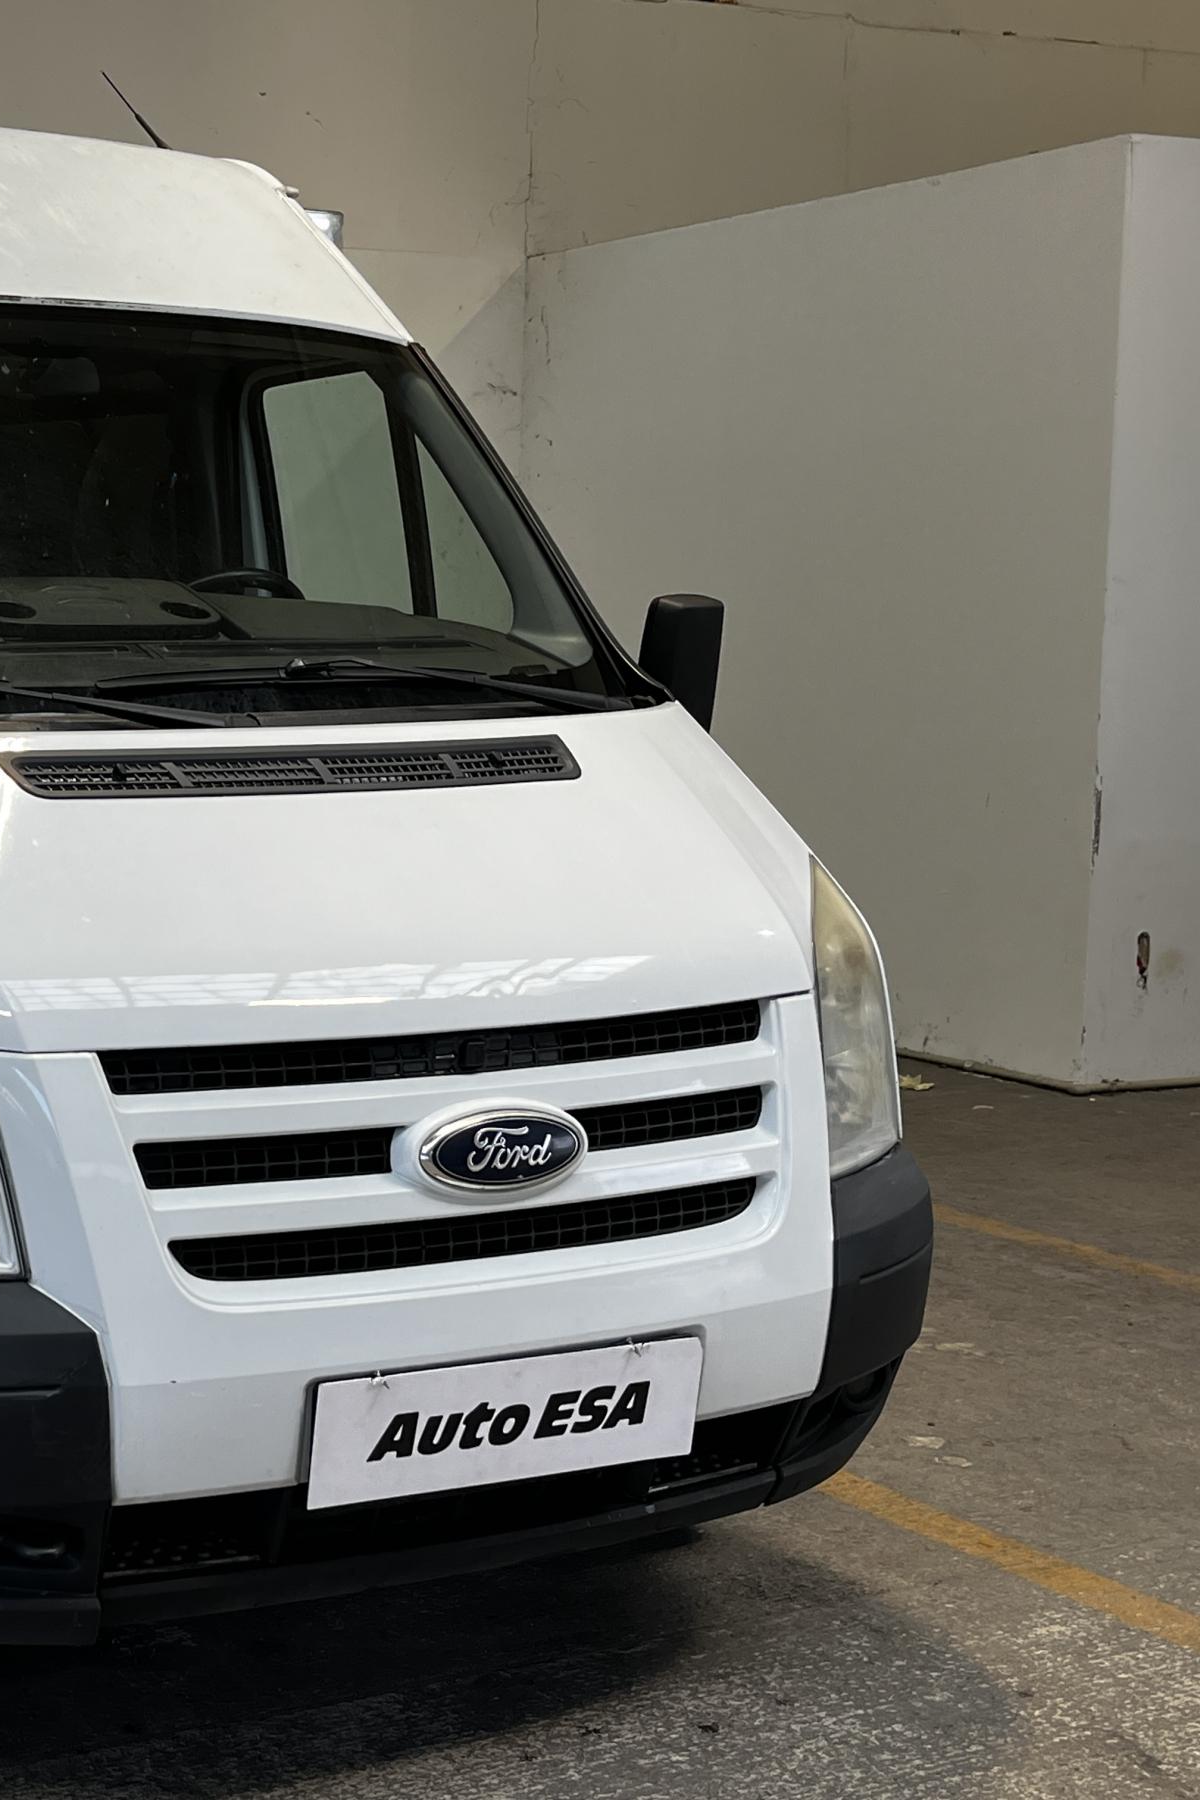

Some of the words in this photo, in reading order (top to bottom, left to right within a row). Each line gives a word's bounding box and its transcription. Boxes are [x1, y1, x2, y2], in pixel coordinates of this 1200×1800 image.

[467, 1126, 552, 1172] Ford
[366, 1401, 531, 1462] Auto
[533, 1380, 651, 1440] ESA
